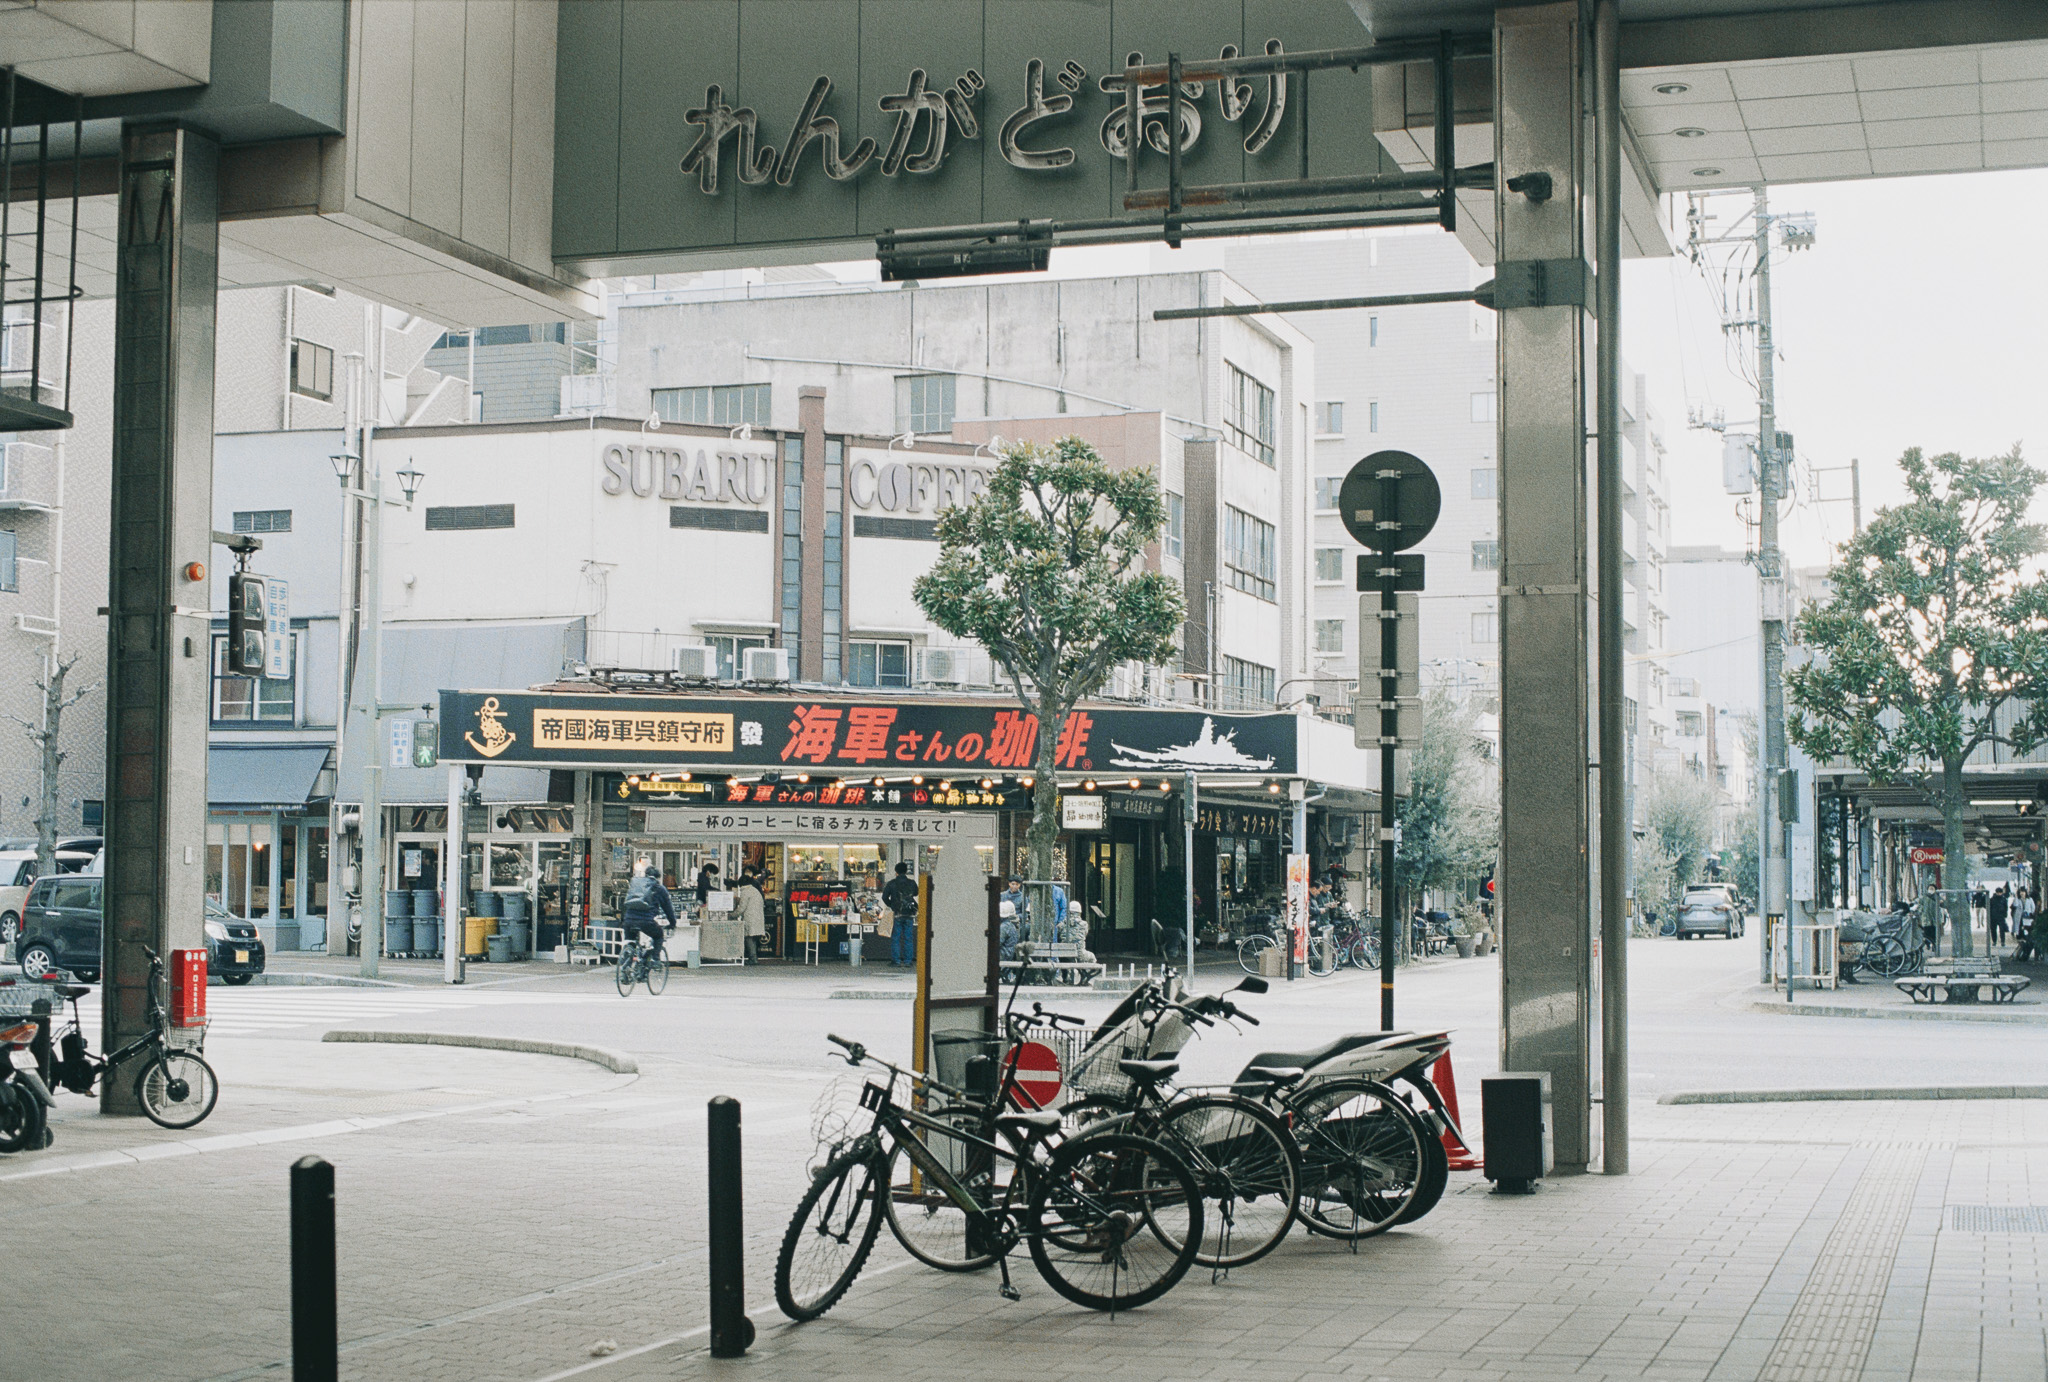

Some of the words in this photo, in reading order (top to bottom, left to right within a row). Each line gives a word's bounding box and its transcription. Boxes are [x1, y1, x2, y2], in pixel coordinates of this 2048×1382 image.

[680, 38, 1286, 194] れんがどおり
[601, 444, 775, 504] SUBARU
[850, 459, 997, 511] COFFE
[541, 718, 725, 744] 帝國海軍呉鎮守府
[689, 815, 956, 833] 一杯のコーヒーに宿るチカラを信じて!!
